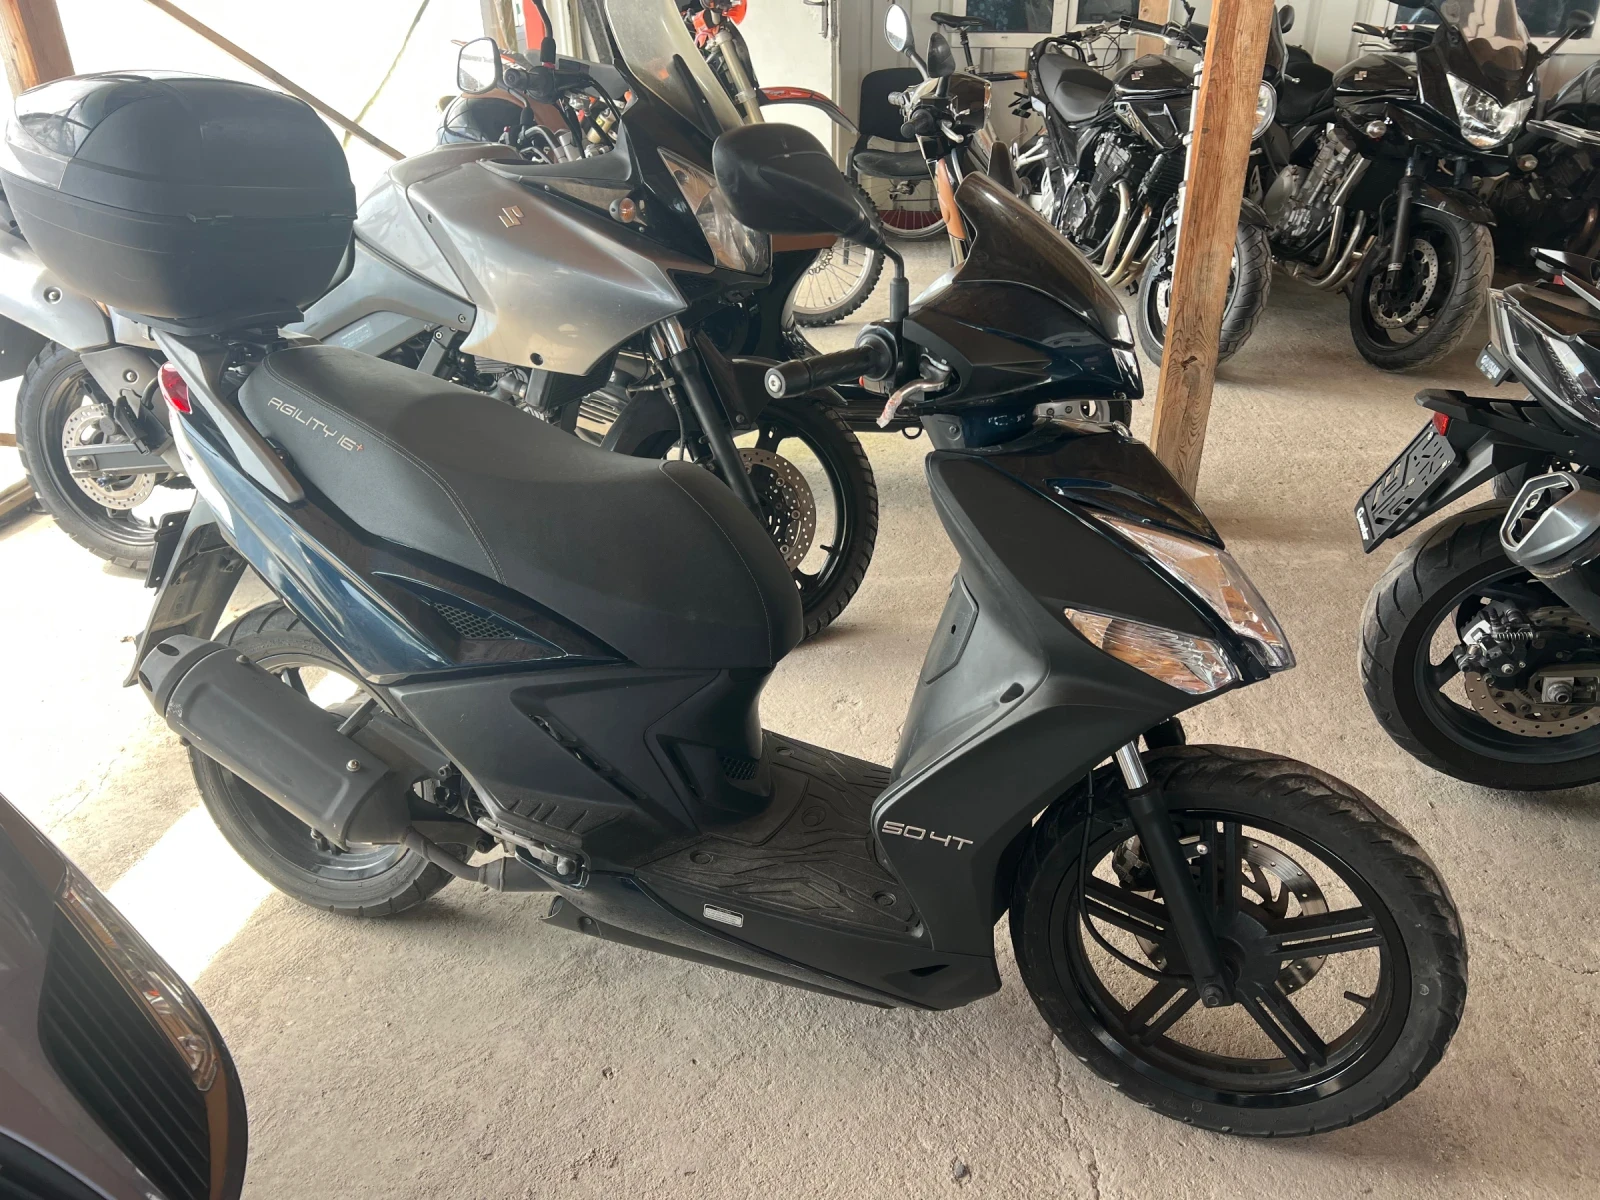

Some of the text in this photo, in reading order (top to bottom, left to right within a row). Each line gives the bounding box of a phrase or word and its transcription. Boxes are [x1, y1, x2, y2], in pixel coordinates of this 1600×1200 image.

[267, 397, 337, 438] AGILITY
[881, 821, 974, 851] 50 4T
